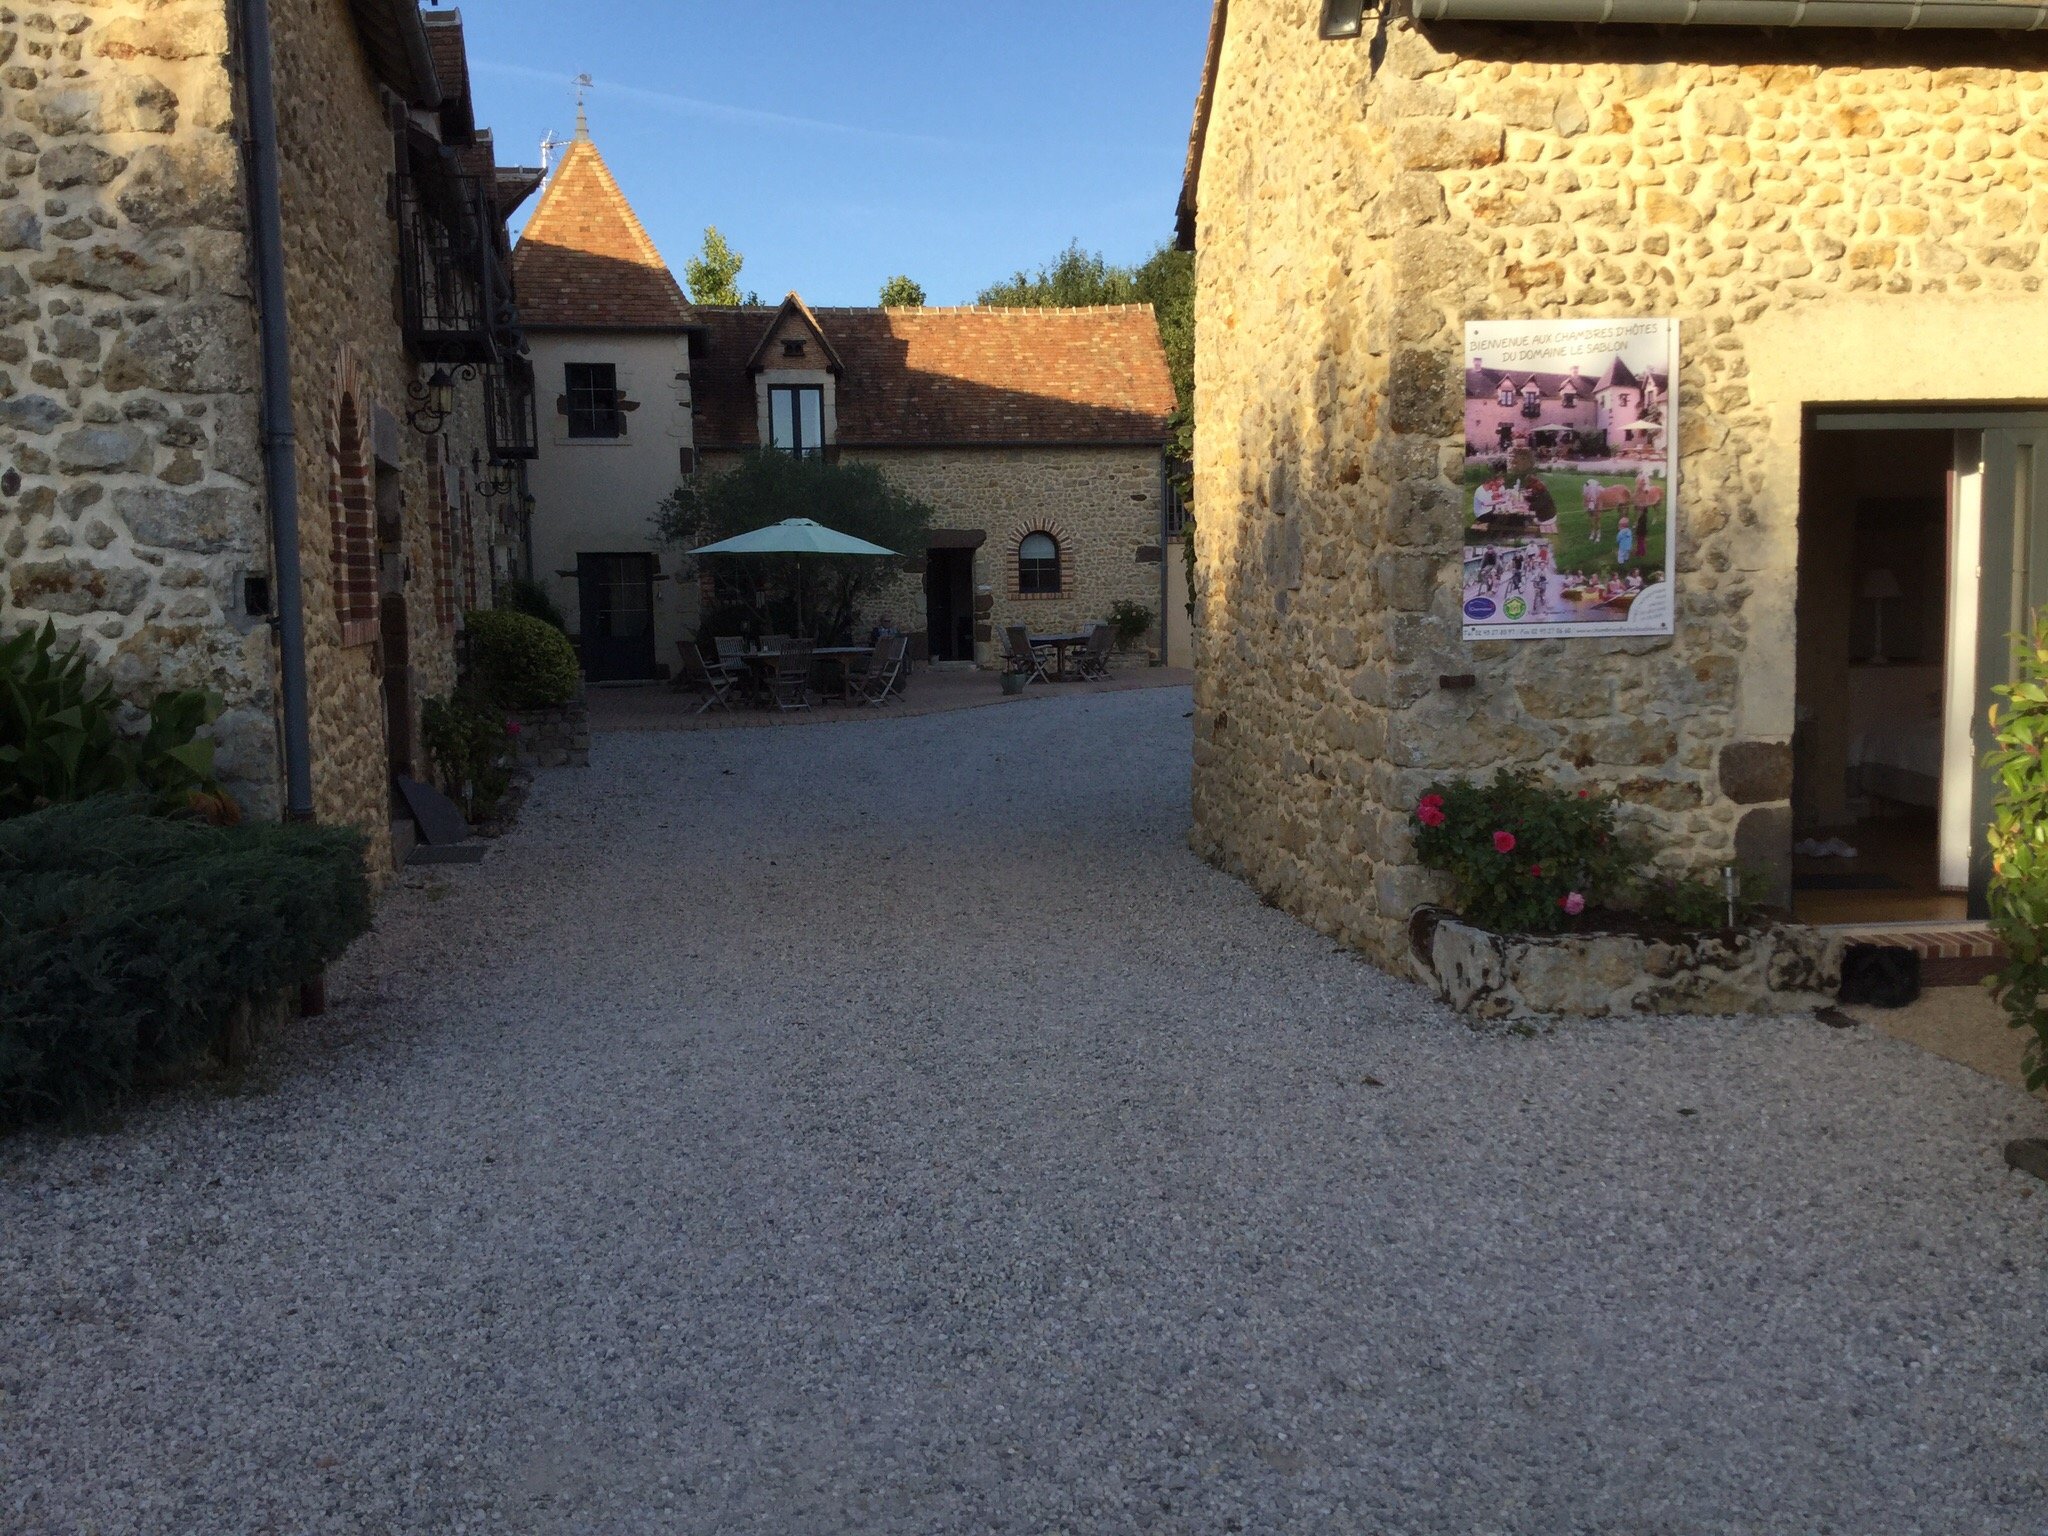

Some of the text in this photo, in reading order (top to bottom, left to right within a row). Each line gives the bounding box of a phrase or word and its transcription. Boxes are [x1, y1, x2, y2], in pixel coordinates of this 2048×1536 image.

[1469, 323, 1658, 352] BIENVENUE AUX CHAMBRES D'HÔTES
[1502, 340, 1628, 362] DU DOMAINE LE SABLON
